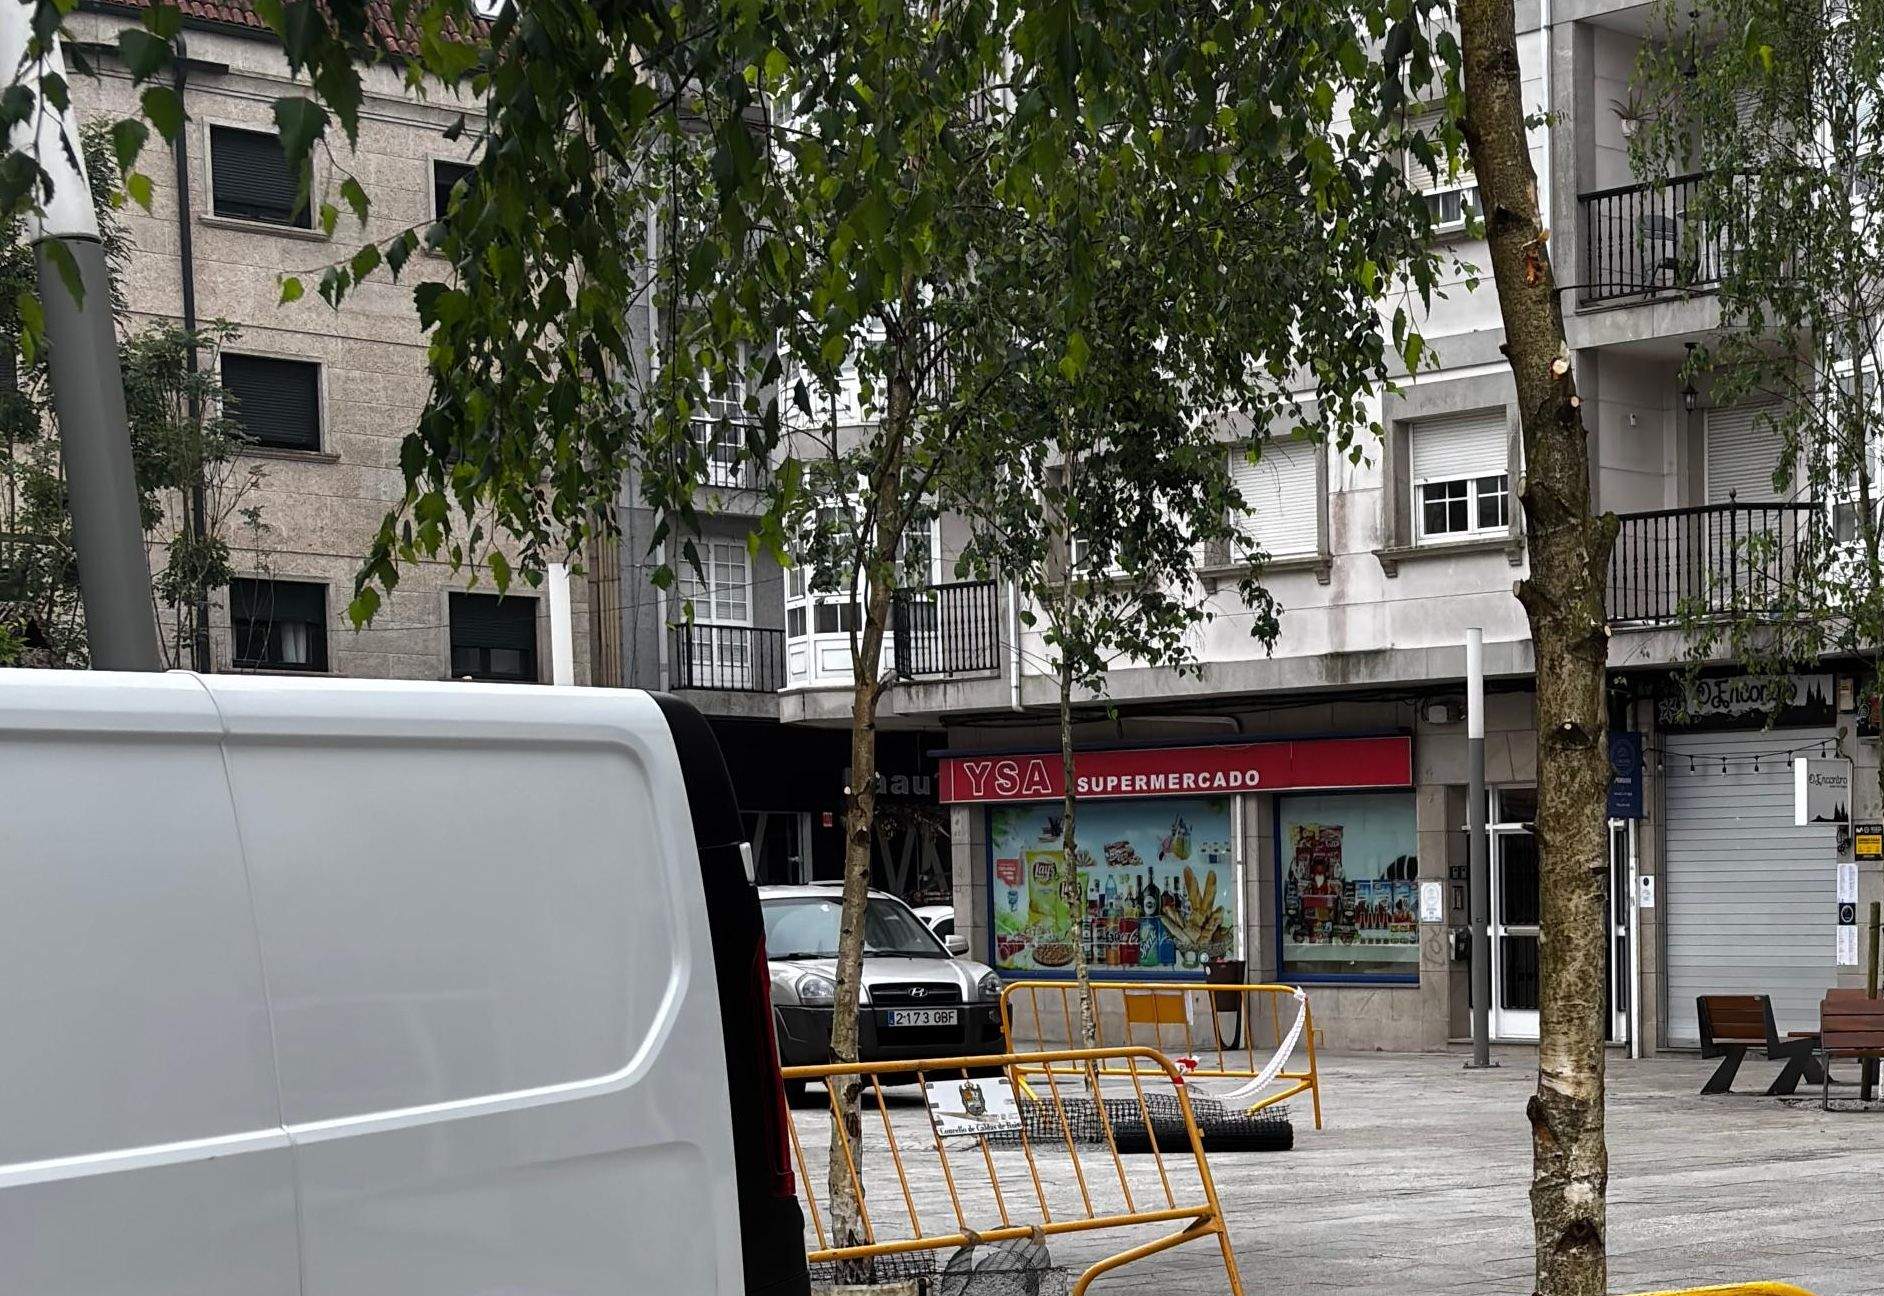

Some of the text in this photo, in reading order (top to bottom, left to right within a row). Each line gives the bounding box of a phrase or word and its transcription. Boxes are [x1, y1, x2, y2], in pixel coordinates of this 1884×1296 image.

[963, 759, 1260, 796] YSA SUPERMERCADO
[896, 1011, 955, 1025] 2173 GBF
